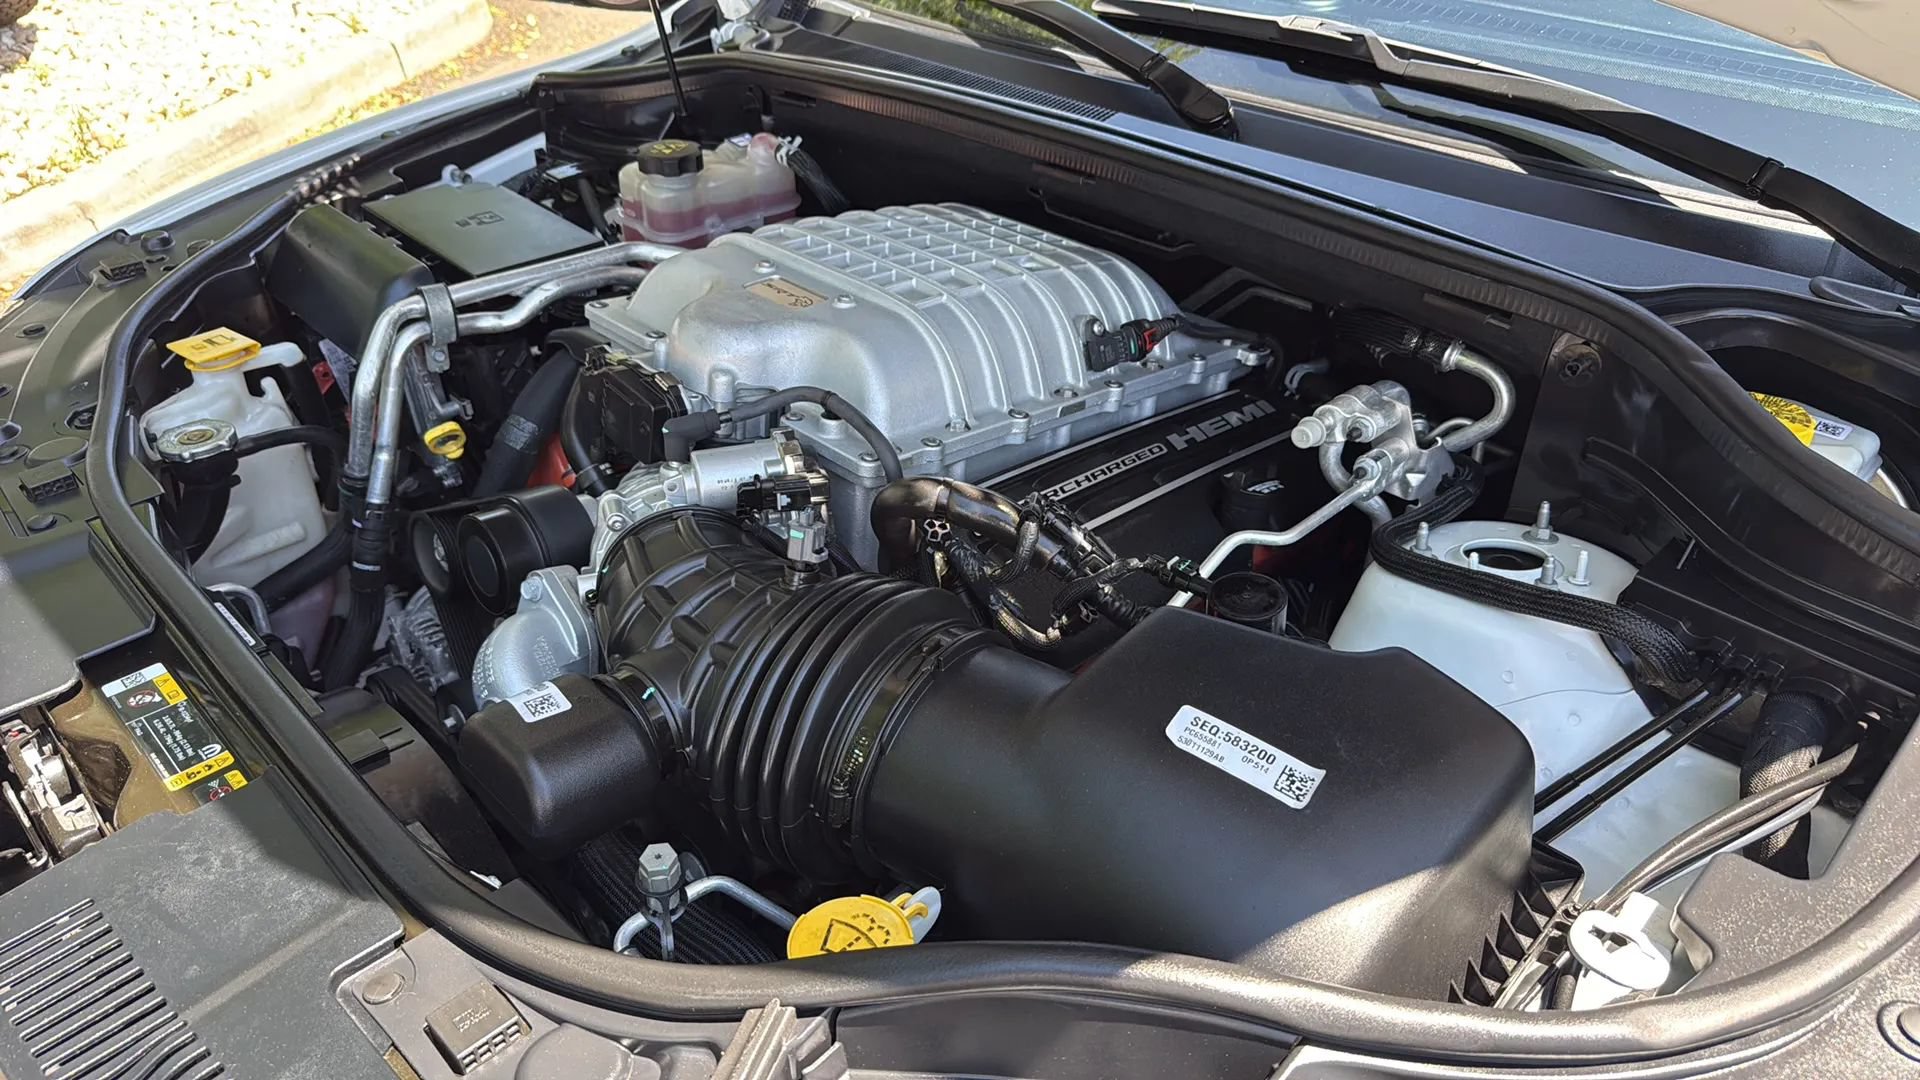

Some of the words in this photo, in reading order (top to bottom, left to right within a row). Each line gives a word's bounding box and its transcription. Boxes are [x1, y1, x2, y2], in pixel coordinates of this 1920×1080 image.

[1166, 399, 1276, 451] HEMI
[1184, 726, 1222, 749] PC655881
[1189, 716, 1277, 766] SEQ:583200
